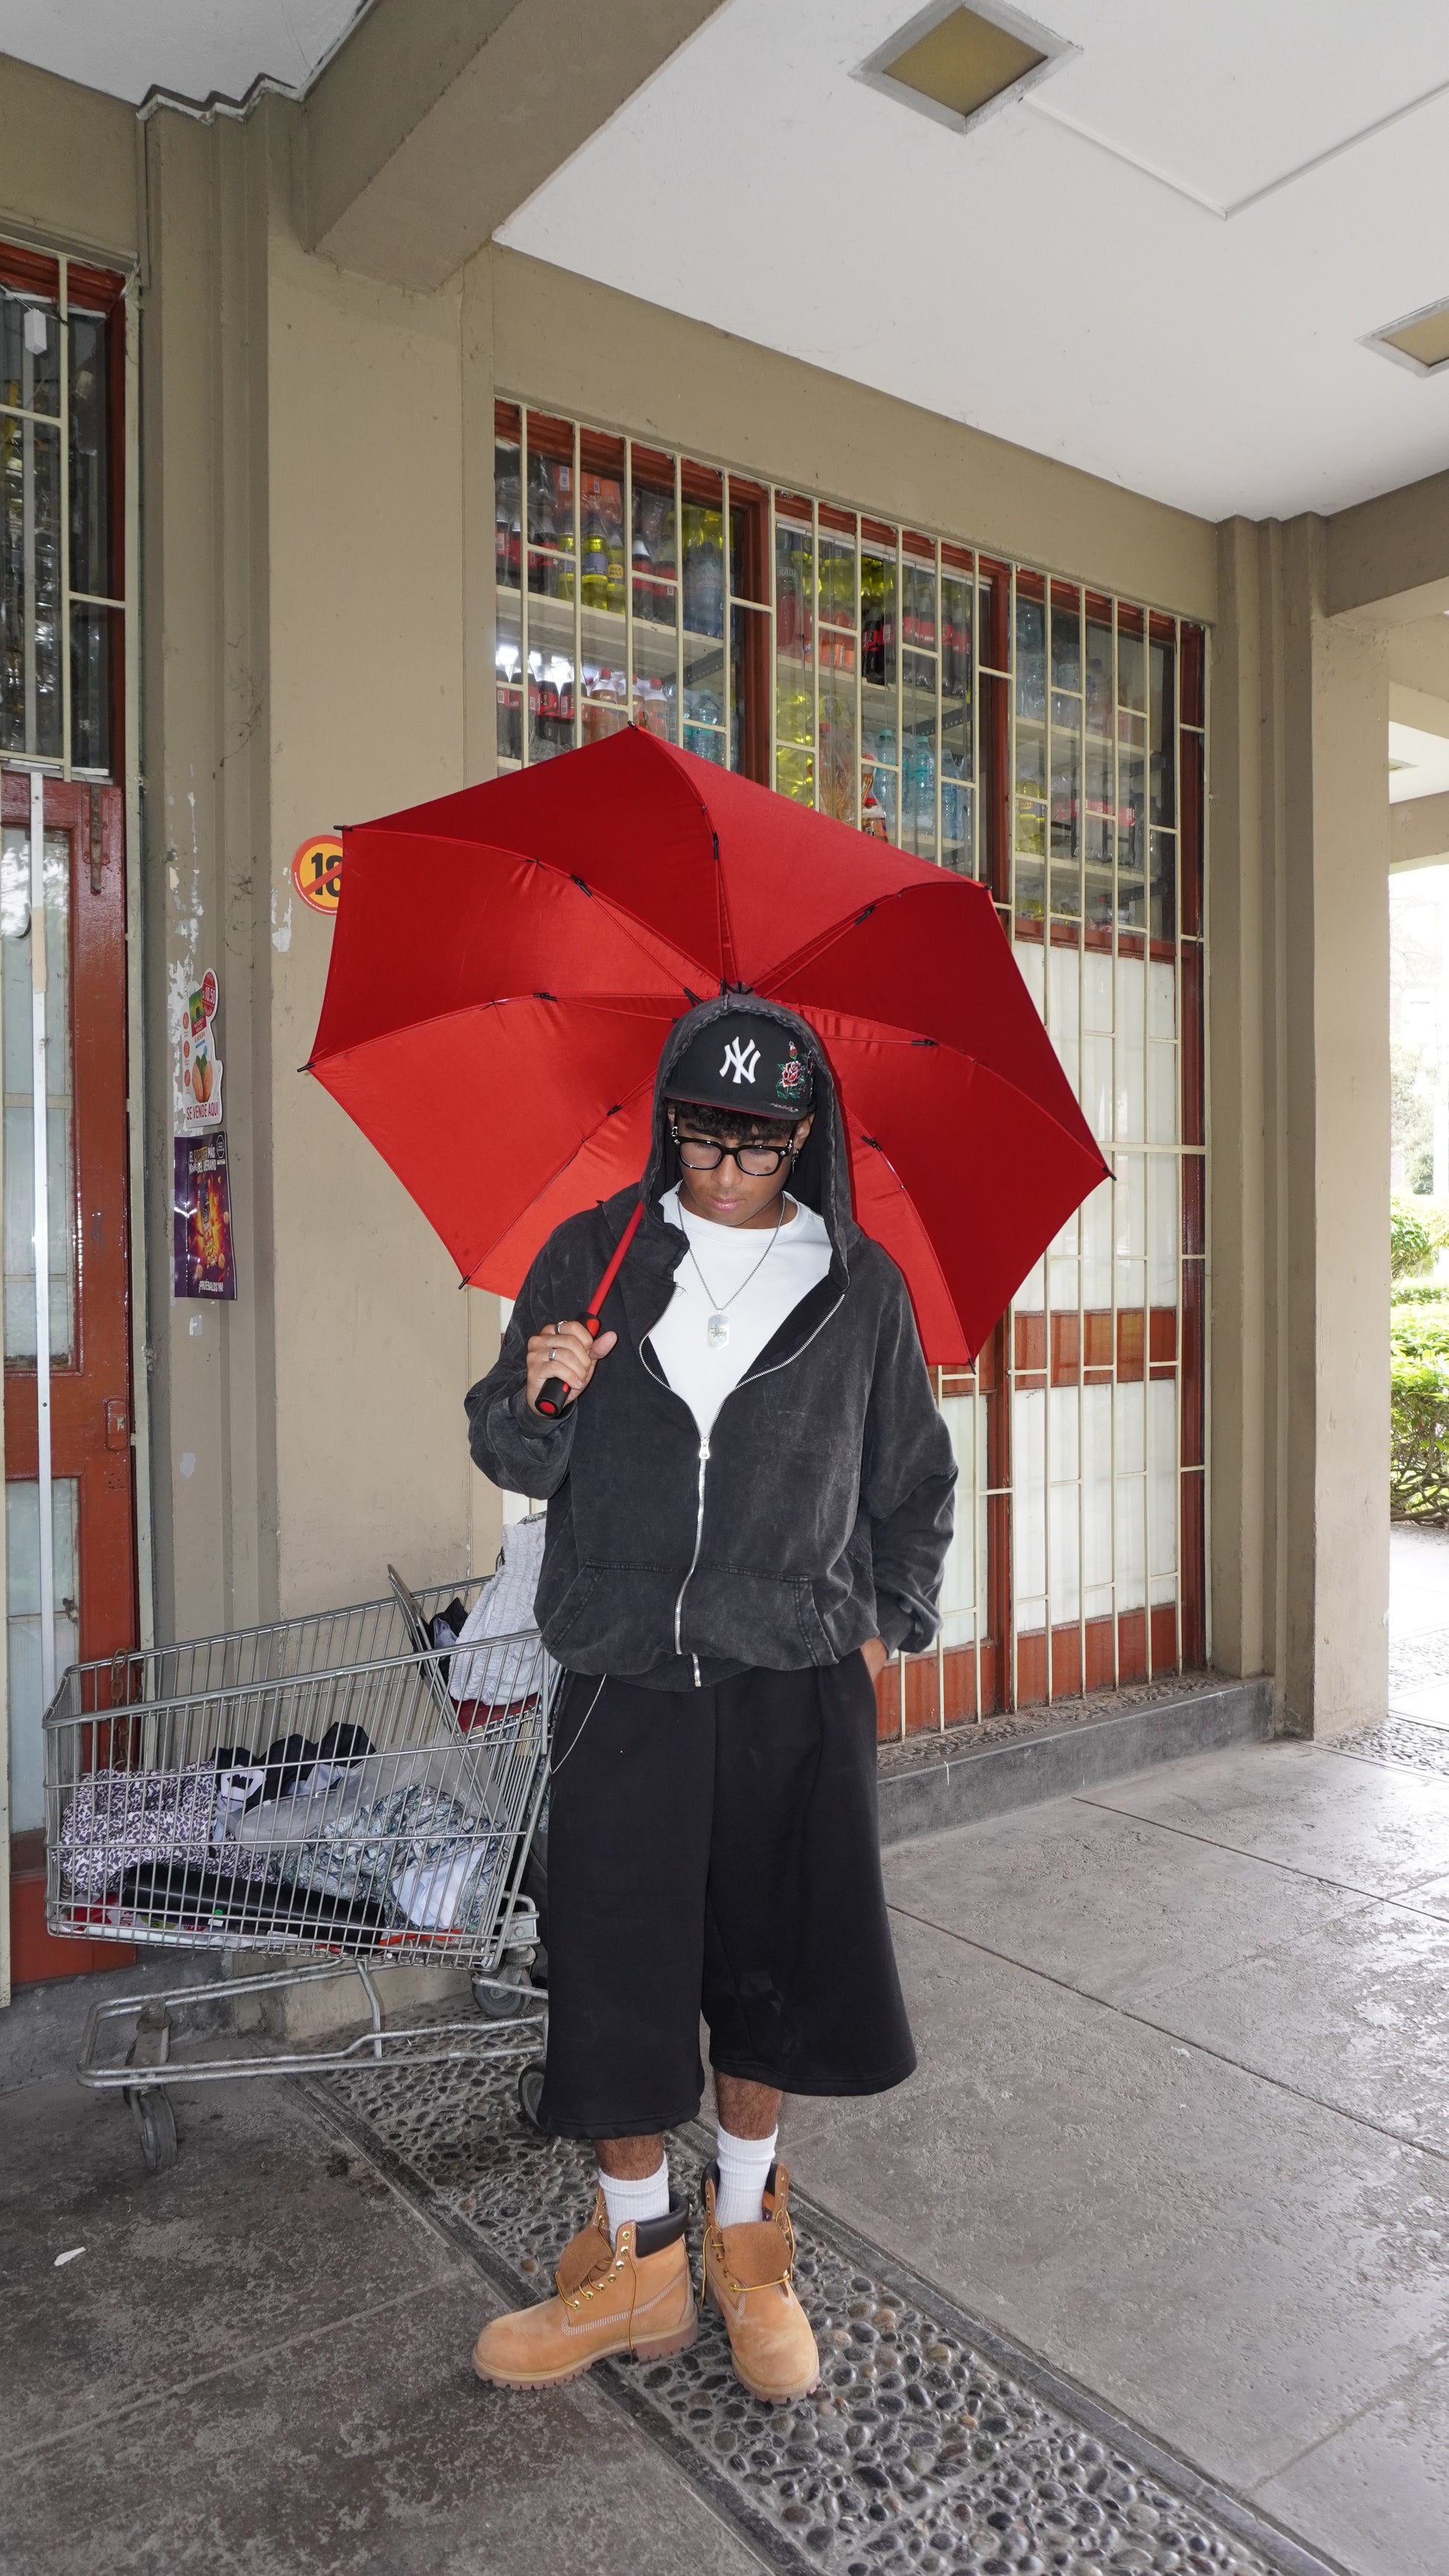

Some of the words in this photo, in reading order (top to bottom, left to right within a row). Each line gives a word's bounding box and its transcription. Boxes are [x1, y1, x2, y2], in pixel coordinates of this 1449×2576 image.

[719, 1036, 761, 1084] NY
[186, 1107, 191, 1120] SE
[193, 1104, 207, 1119] VENDE
